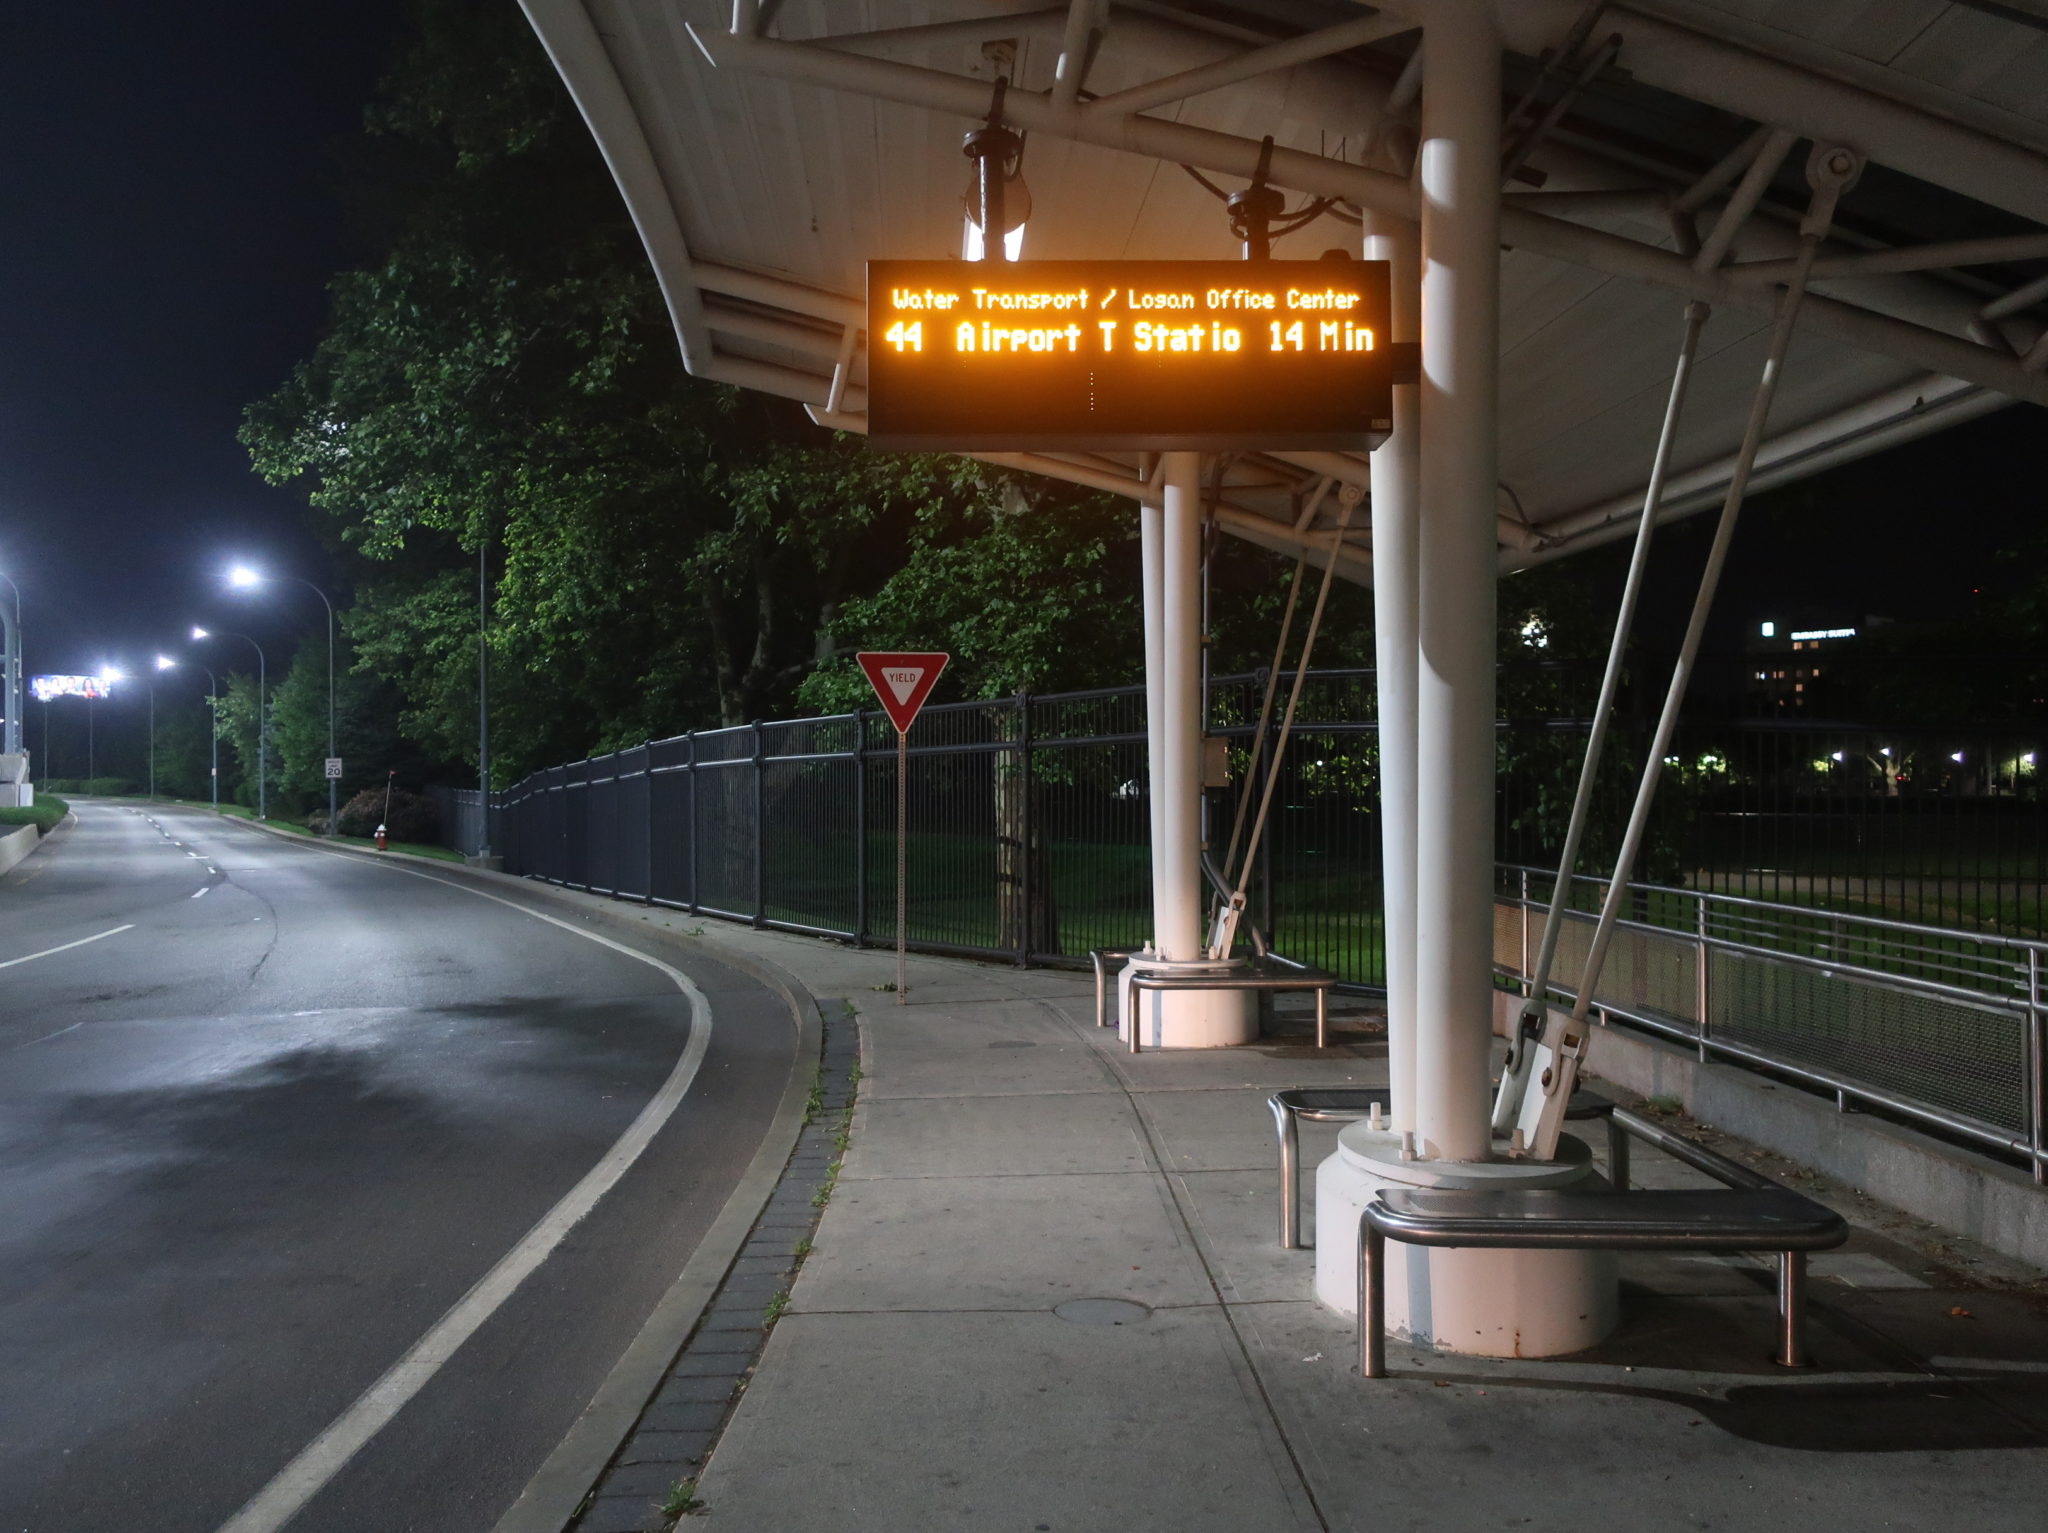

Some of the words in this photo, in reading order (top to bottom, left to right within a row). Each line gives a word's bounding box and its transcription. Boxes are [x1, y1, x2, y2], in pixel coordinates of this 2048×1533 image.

[892, 288, 960, 309] Water
[972, 288, 1089, 309] Transport
[1100, 288, 1116, 309] /
[1128, 288, 1195, 309] Logan
[1206, 288, 1275, 309] Office
[1286, 288, 1360, 309] Center
[884, 320, 922, 352] 44
[956, 320, 1081, 352] Airport
[1099, 320, 1116, 352] T
[1134, 320, 1241, 352] Statio
[1270, 320, 1303, 352] 14
[1319, 320, 1374, 352] Min
[889, 673, 916, 683] YIELD
[327, 767, 341, 776] 20
